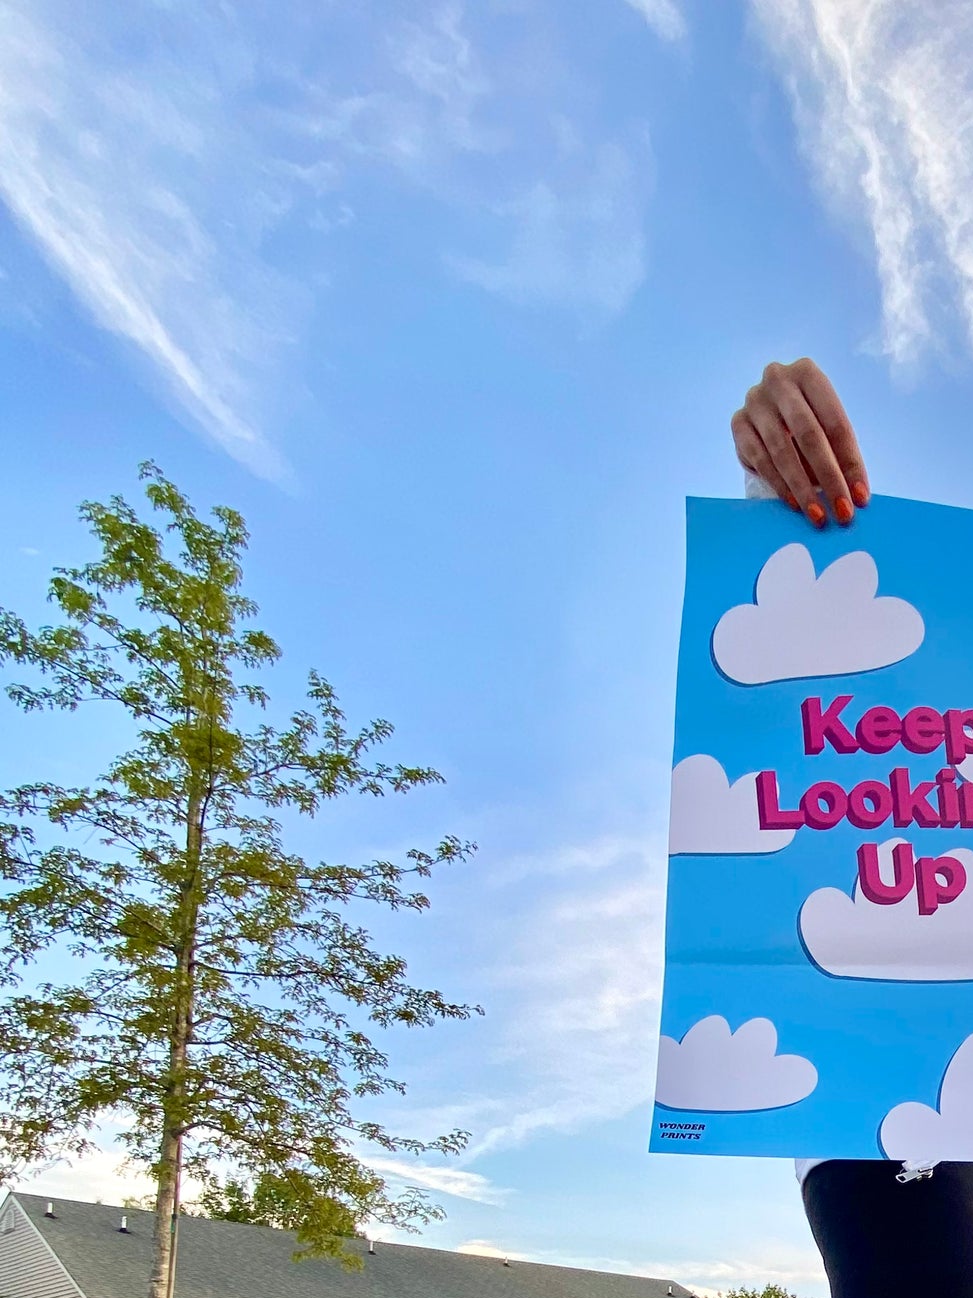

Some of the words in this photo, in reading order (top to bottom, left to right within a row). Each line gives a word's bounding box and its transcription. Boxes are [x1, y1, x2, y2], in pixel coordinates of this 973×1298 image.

[857, 843, 967, 916] Up
[659, 1122, 706, 1131] WONDER
[660, 1132, 702, 1140] PRINTS
